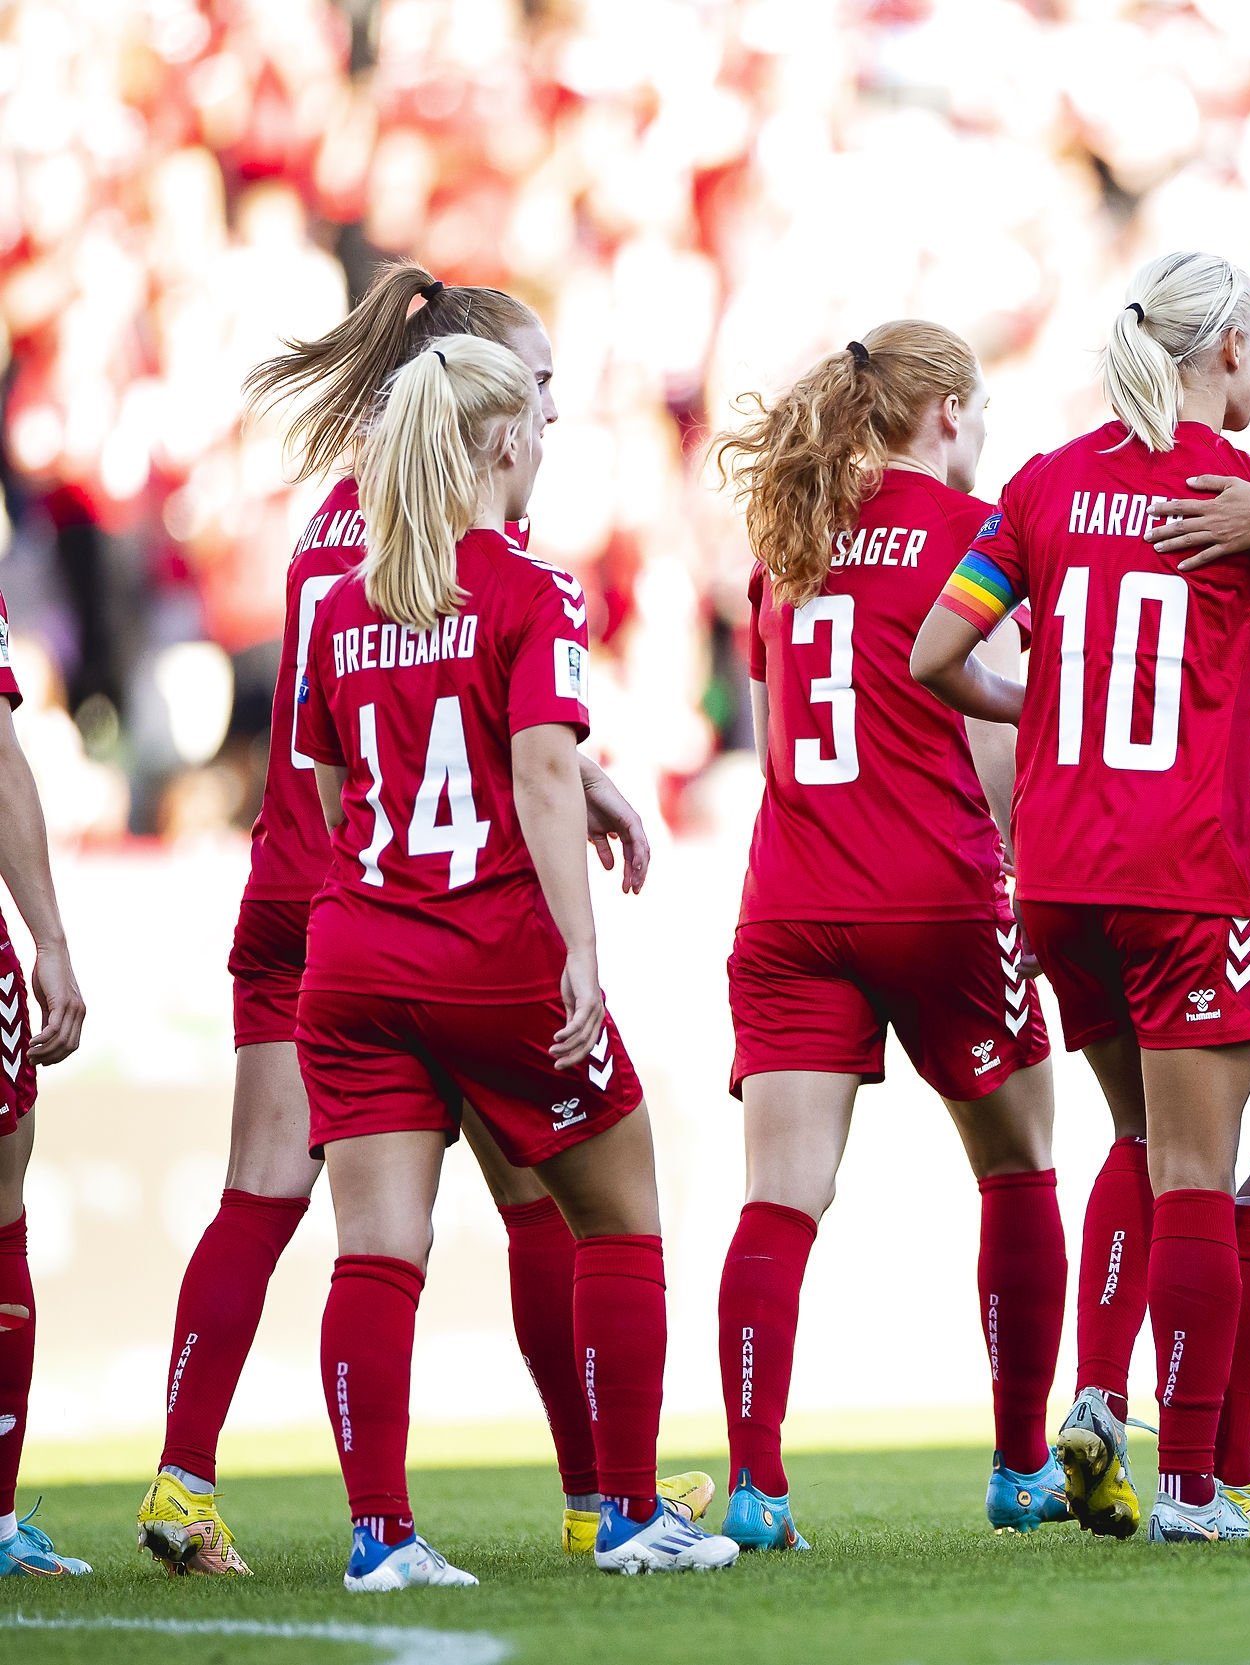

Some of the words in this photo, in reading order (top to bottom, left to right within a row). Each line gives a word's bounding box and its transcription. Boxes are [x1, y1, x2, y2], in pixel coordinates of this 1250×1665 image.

[829, 527, 928, 568] SAGER
[332, 614, 478, 679] BREDGAARD
[1053, 566, 1189, 771] 10
[790, 594, 860, 784] 3
[358, 696, 491, 889] 14
[1185, 1008, 1221, 1022] hummel
[974, 1055, 1001, 1077] hummel
[552, 1111, 587, 1132] hummel
[1100, 1230, 1125, 1305] DANMARK
[167, 1332, 199, 1414] DANMARK
[742, 1327, 754, 1418] DANMARK
[988, 1293, 999, 1381] DANMARK
[1163, 1330, 1186, 1408] DANMARK
[337, 1362, 354, 1453] DANMARK
[586, 1347, 598, 1422] DANMARK
